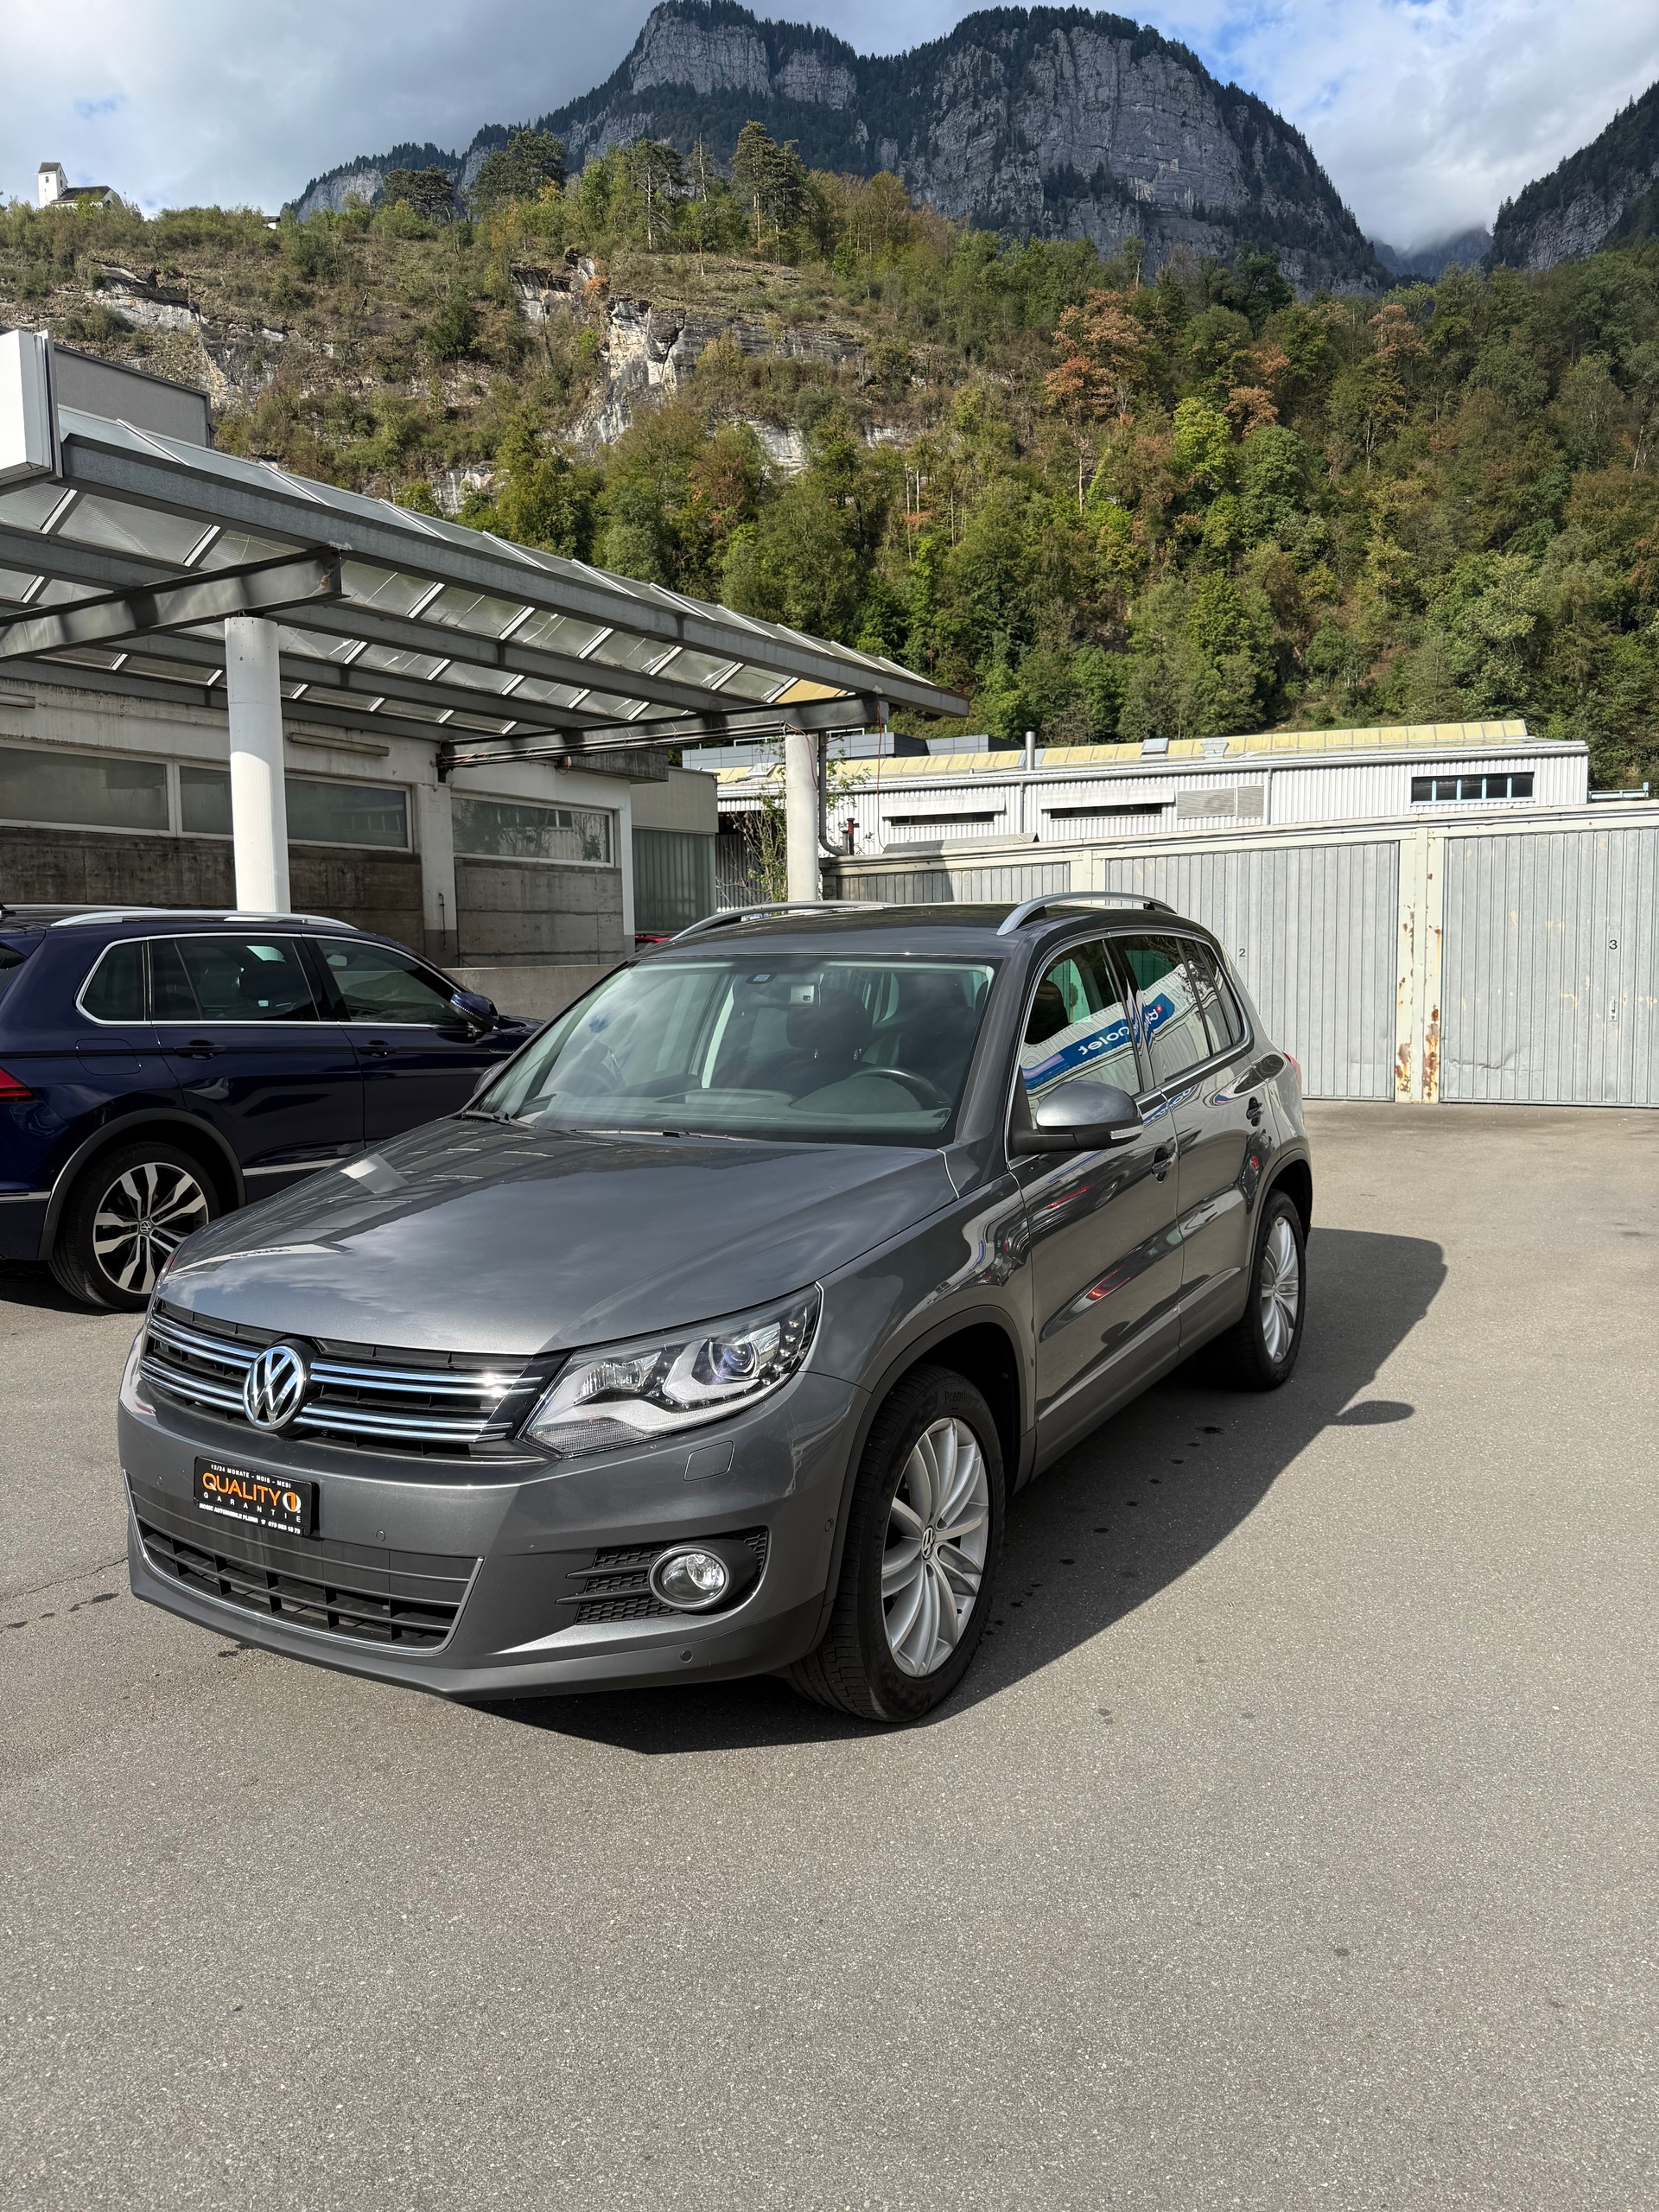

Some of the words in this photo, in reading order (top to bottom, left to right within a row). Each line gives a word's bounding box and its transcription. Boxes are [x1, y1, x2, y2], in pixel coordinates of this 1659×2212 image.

[1239, 948, 1246, 957] 2
[1609, 939, 1618, 950] 3
[227, 1468, 250, 1478] MONATE
[256, 1474, 270, 1484] MOIS
[276, 1480, 291, 1489] MESI
[202, 1472, 281, 1507] QUALITY
[204, 1491, 302, 1523] GARANTIE
